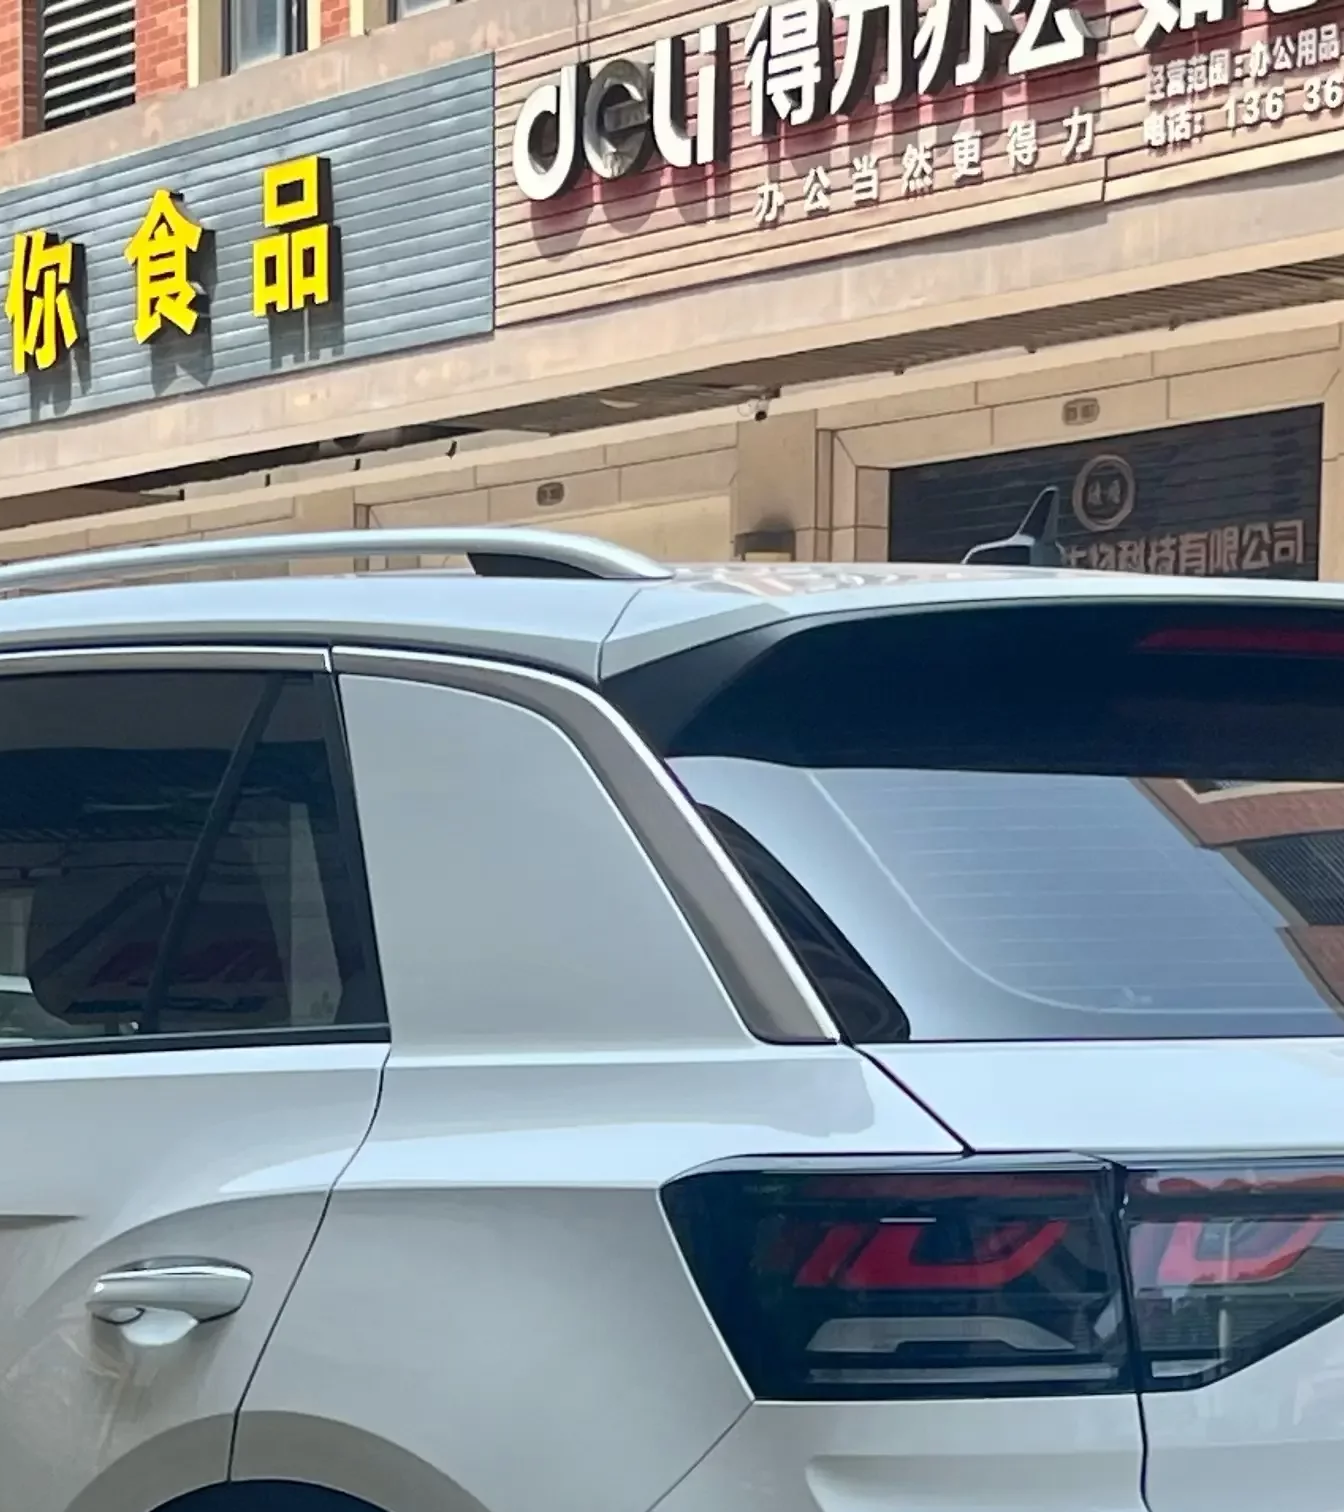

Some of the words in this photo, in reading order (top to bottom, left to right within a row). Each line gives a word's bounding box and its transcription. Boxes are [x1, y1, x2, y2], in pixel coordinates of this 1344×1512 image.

[514, 23, 718, 200] deli
[754, 105, 1096, 224] 办公当然更得力
[1224, 87, 1284, 128] 136
